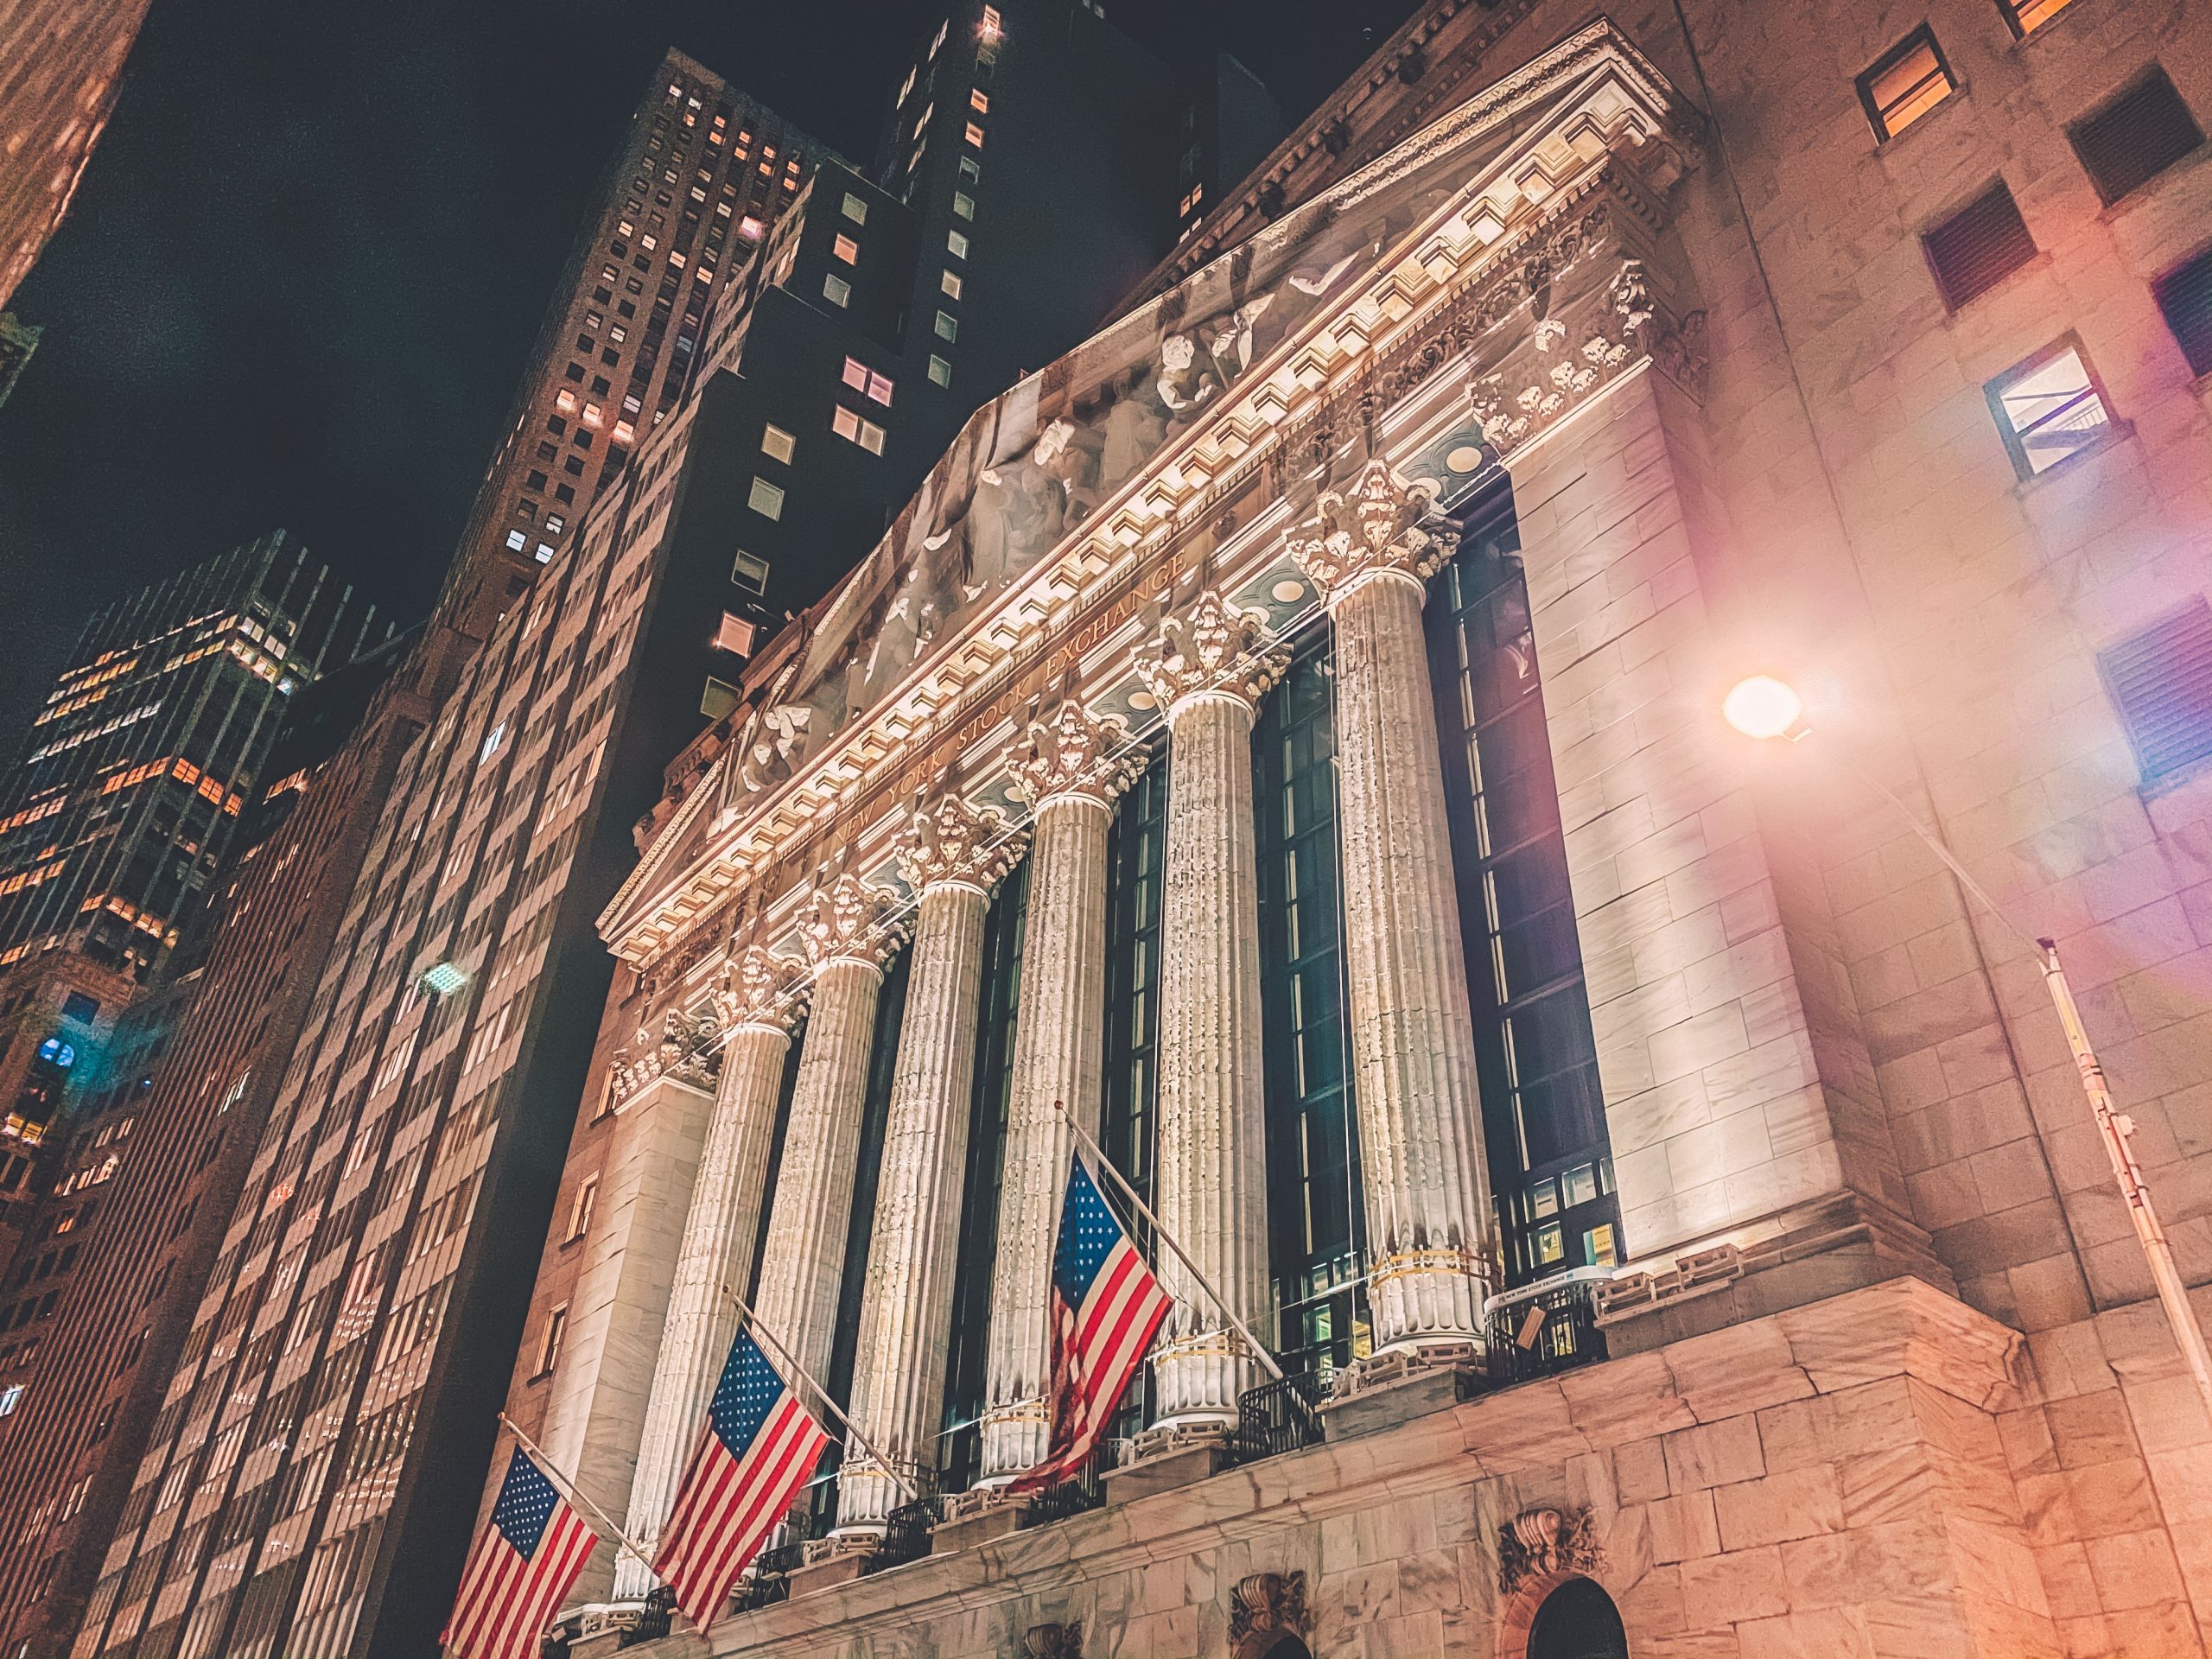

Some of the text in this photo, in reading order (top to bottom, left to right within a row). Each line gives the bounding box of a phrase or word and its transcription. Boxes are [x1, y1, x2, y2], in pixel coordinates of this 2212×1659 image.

[834, 549, 1187, 850] NEW YORK STOCK EXCHANGE
